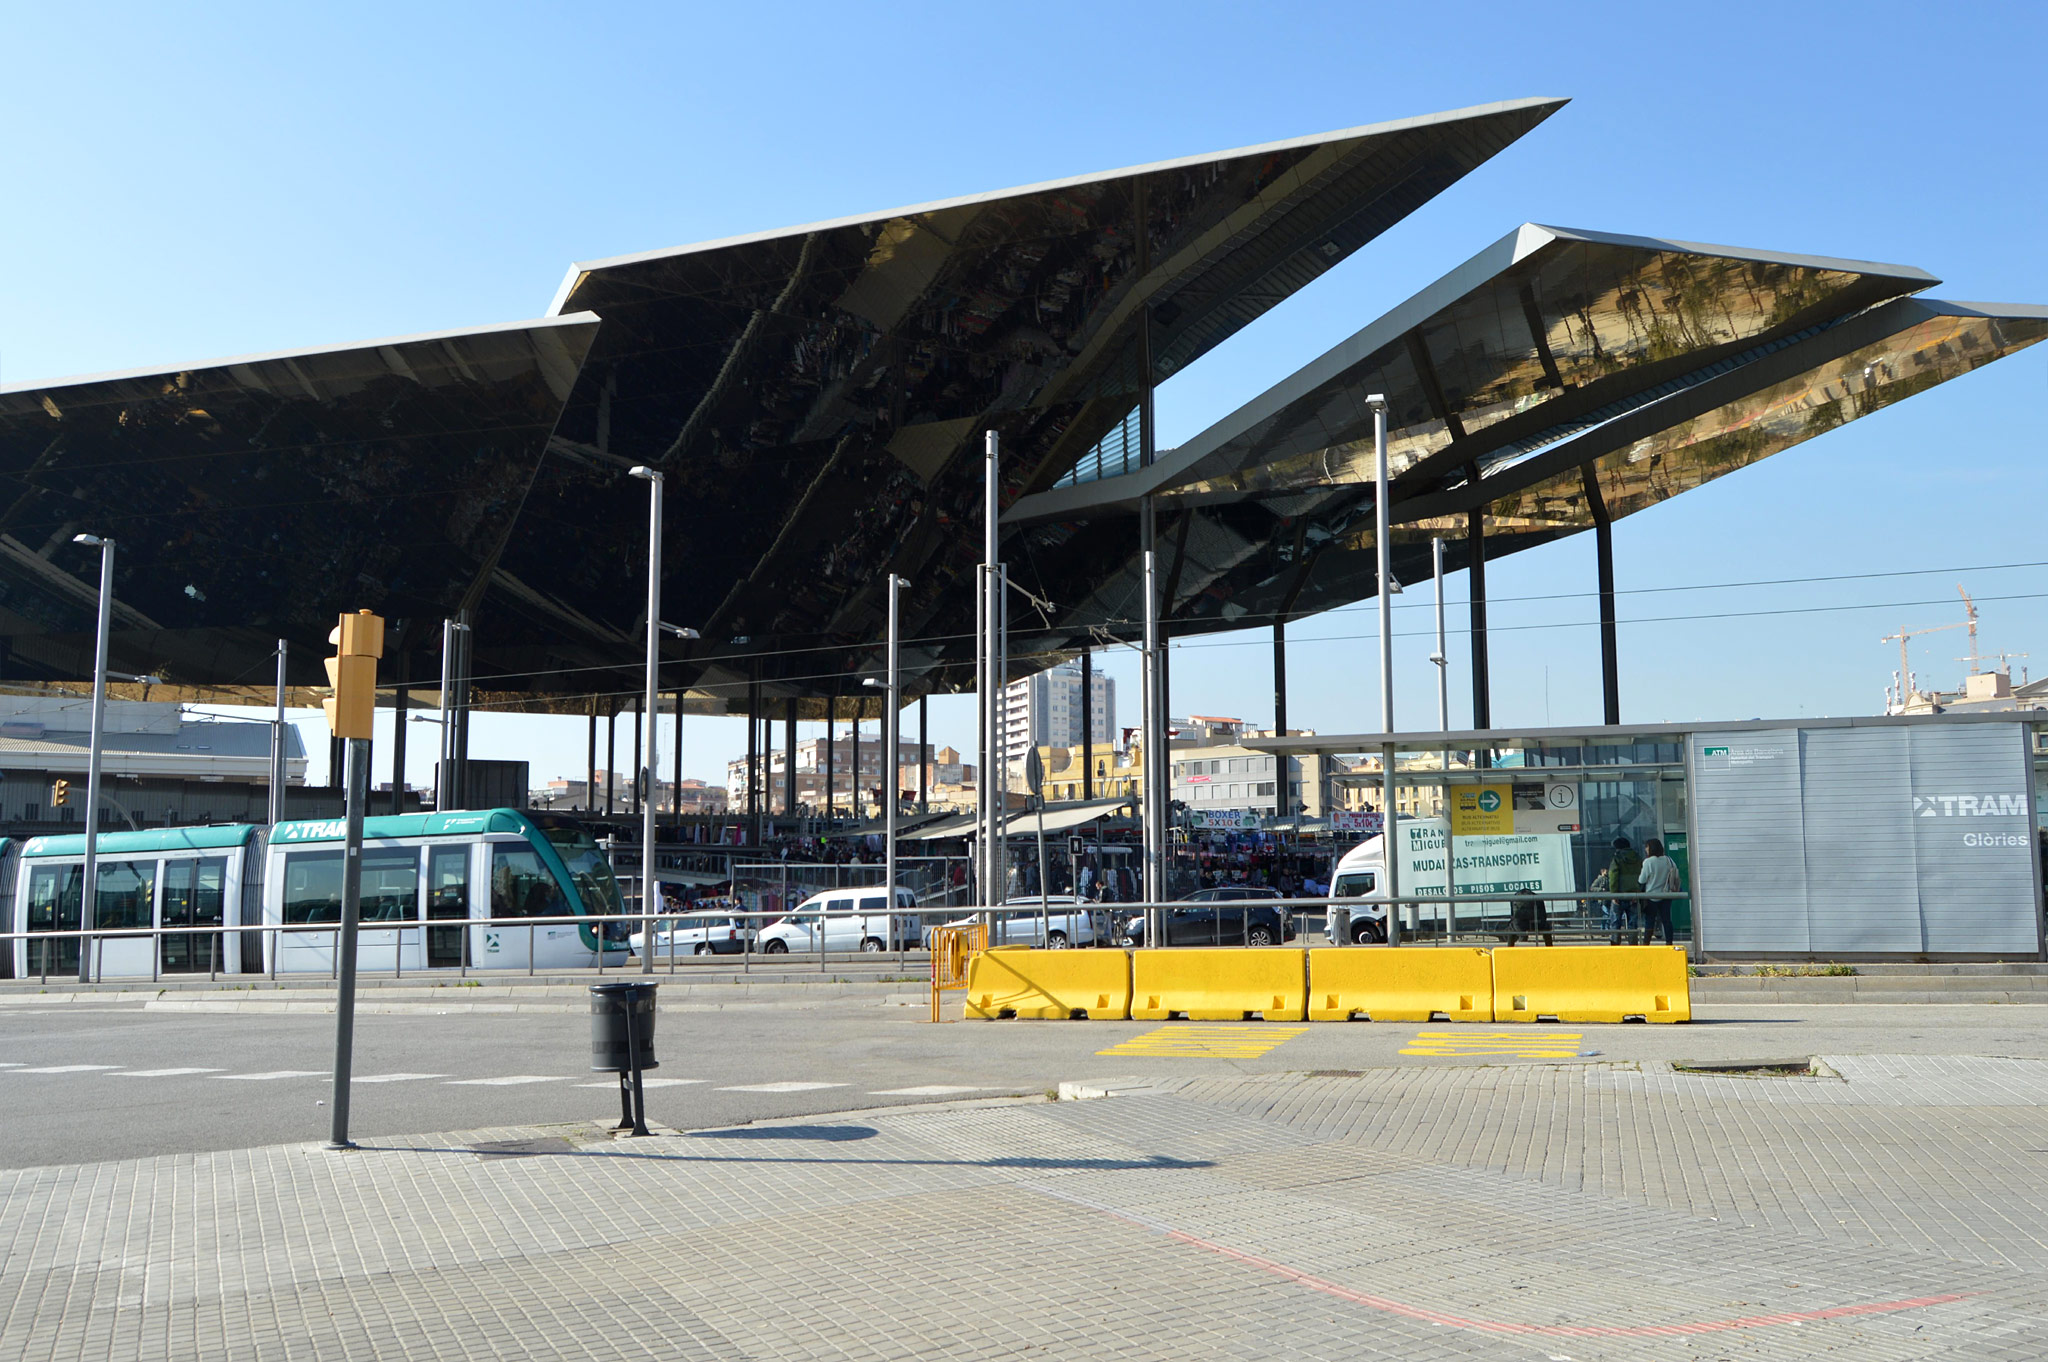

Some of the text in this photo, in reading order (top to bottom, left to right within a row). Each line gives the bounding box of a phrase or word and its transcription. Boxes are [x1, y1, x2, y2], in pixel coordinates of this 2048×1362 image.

[1937, 794, 2029, 817] TRAM
[1208, 811, 1241, 819] BOXER
[1410, 828, 1444, 839] TRAN
[1963, 832, 2028, 847] Glòries
[1411, 839, 1445, 851] MIGUE
[1470, 883, 1495, 893] PISOS
[1503, 881, 1541, 891] LOCALES
[1397, 1031, 1583, 1058] BUS
